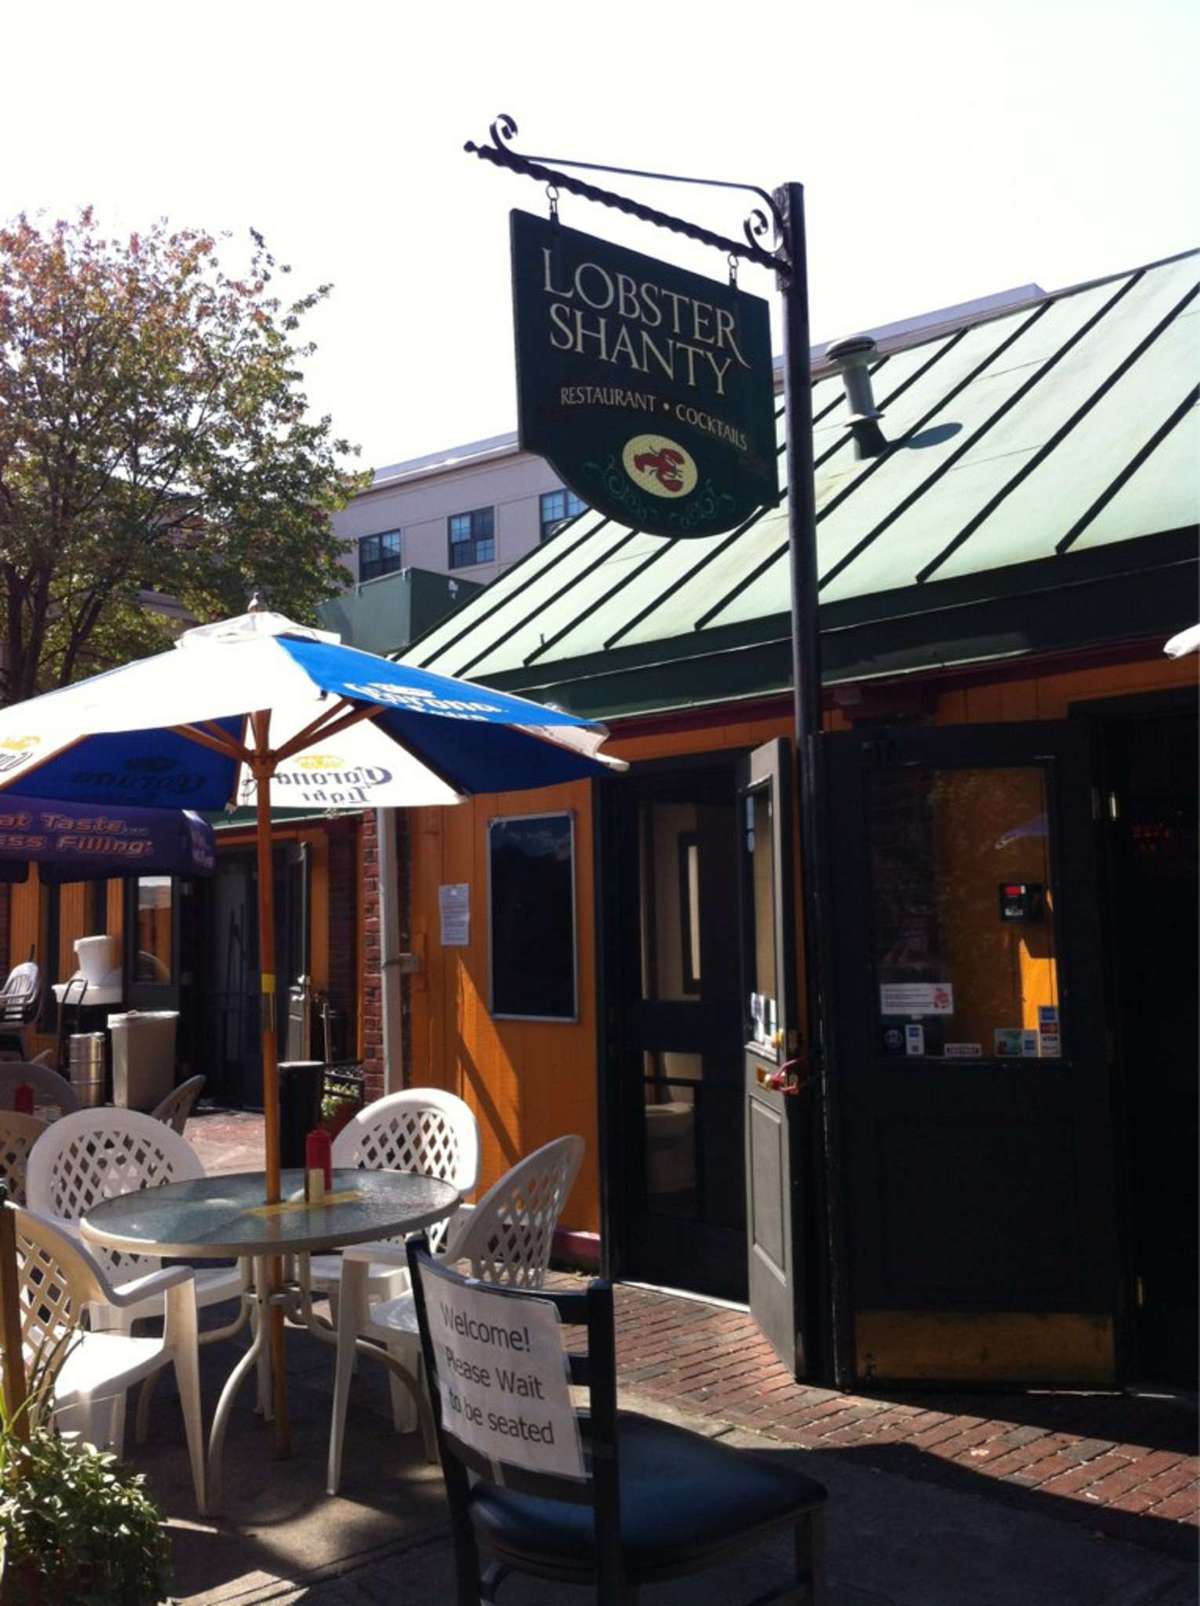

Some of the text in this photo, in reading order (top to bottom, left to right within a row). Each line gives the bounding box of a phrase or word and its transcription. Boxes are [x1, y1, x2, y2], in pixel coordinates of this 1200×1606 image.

[542, 247, 751, 369] LOBSTER
[550, 303, 734, 395] SHANTY
[560, 386, 748, 451] RESTAURANT COCKTAILS
[440, 1302, 531, 1353] Welcome!
[495, 1367, 544, 1400] Wait
[463, 1395, 483, 1426] be
[487, 1412, 554, 1445] seated
